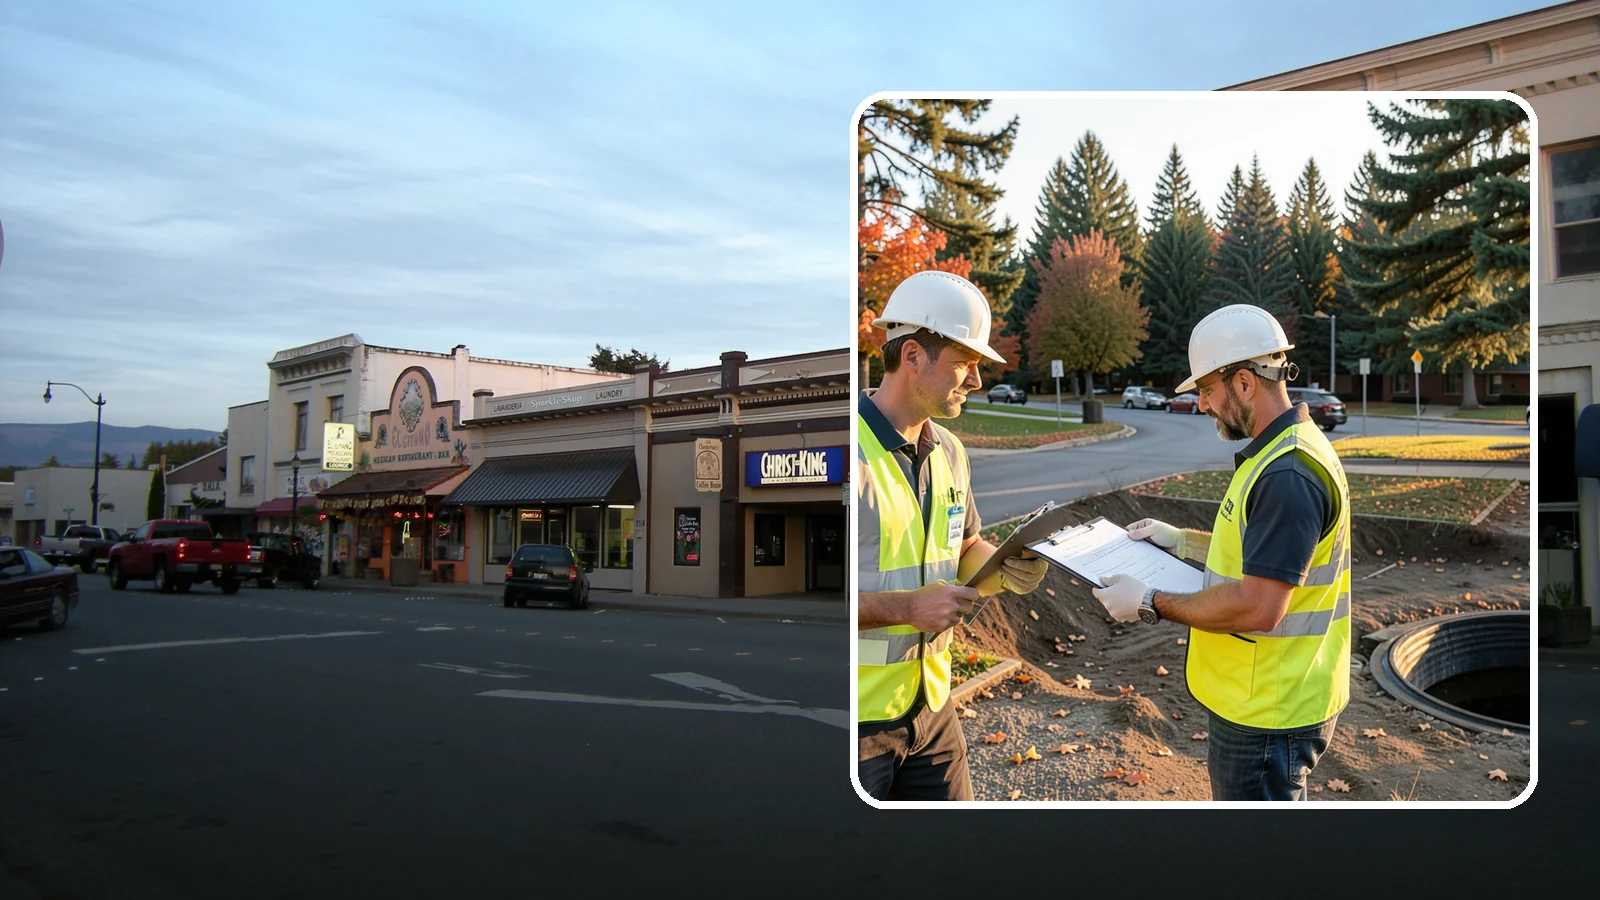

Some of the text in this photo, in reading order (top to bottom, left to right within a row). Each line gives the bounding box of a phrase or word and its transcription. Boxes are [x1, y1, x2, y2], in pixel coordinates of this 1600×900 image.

[561, 394, 583, 403] Shop
[595, 389, 623, 400] LAUNDRY
[493, 402, 522, 412] LAVANDERIA
[373, 454, 396, 464] MEXICAN
[397, 451, 433, 463] RESTAURANT
[437, 450, 450, 459] BAR
[799, 450, 827, 476] KING
